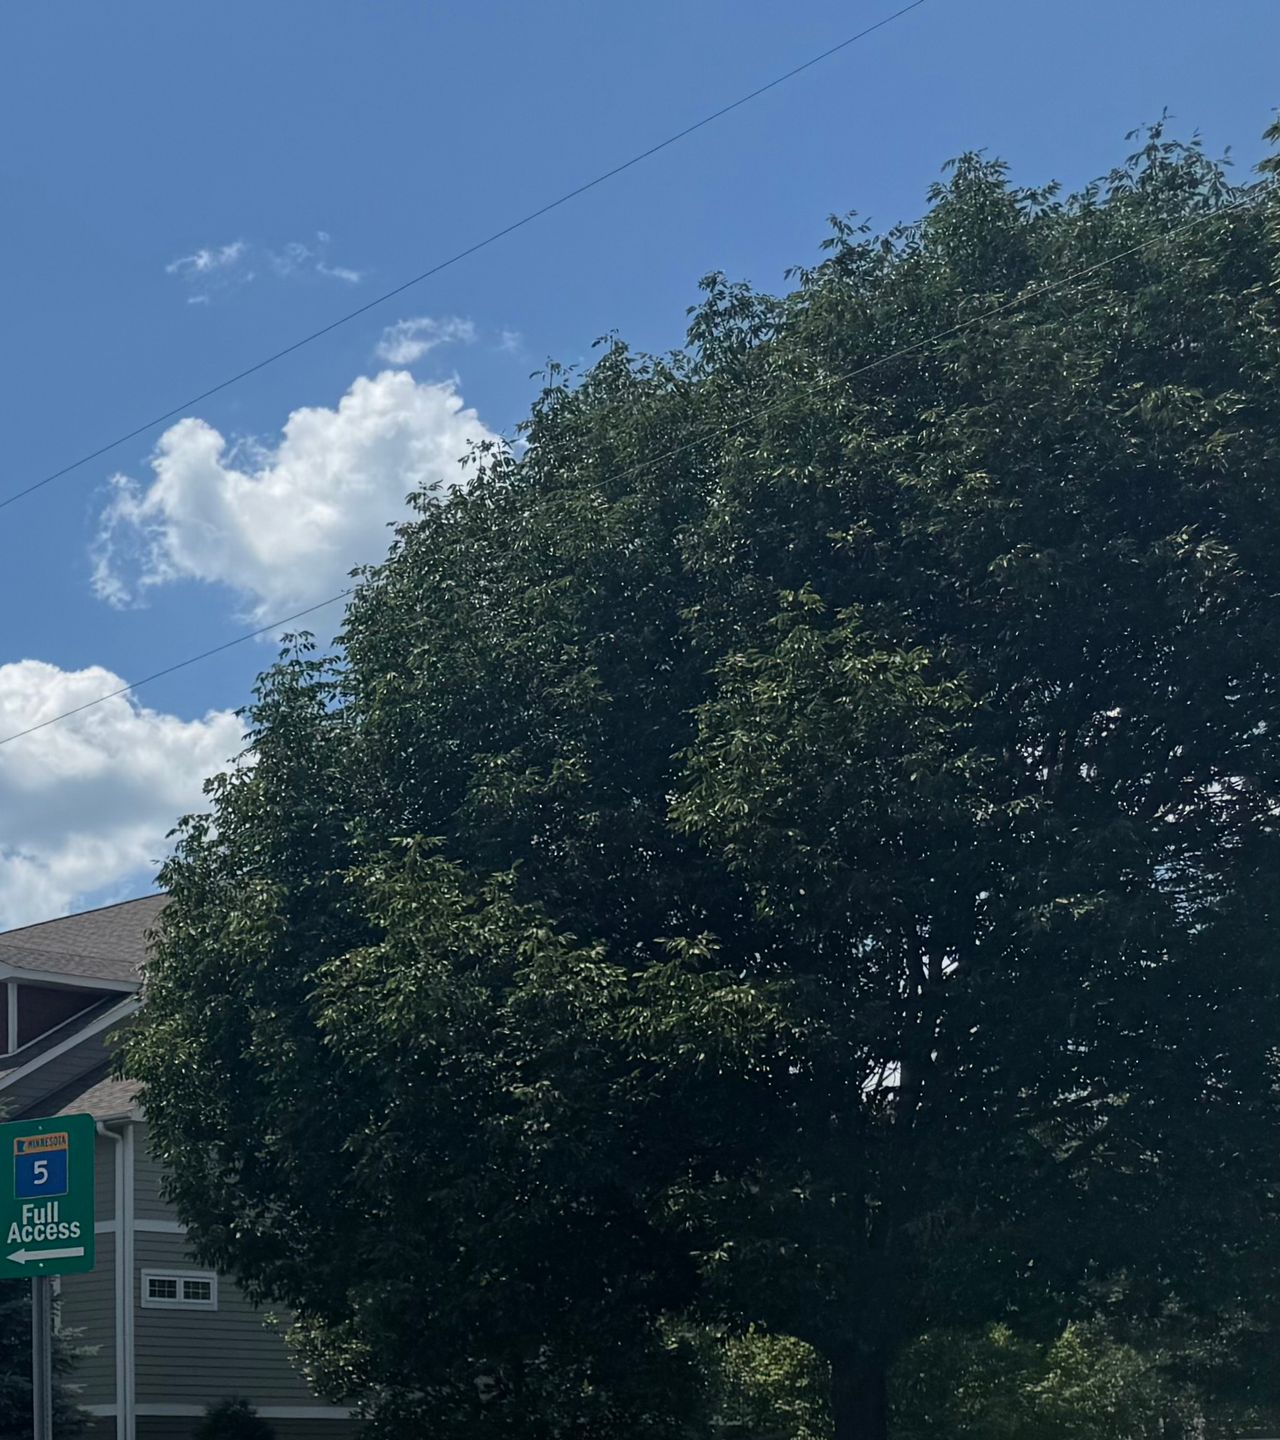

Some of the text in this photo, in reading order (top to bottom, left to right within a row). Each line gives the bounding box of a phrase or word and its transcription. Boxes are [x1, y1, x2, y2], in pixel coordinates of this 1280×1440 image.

[27, 1135, 66, 1149] MINNESOTA
[33, 1160, 48, 1185] 5
[22, 1201, 59, 1225] Full
[7, 1221, 81, 1244] Access
